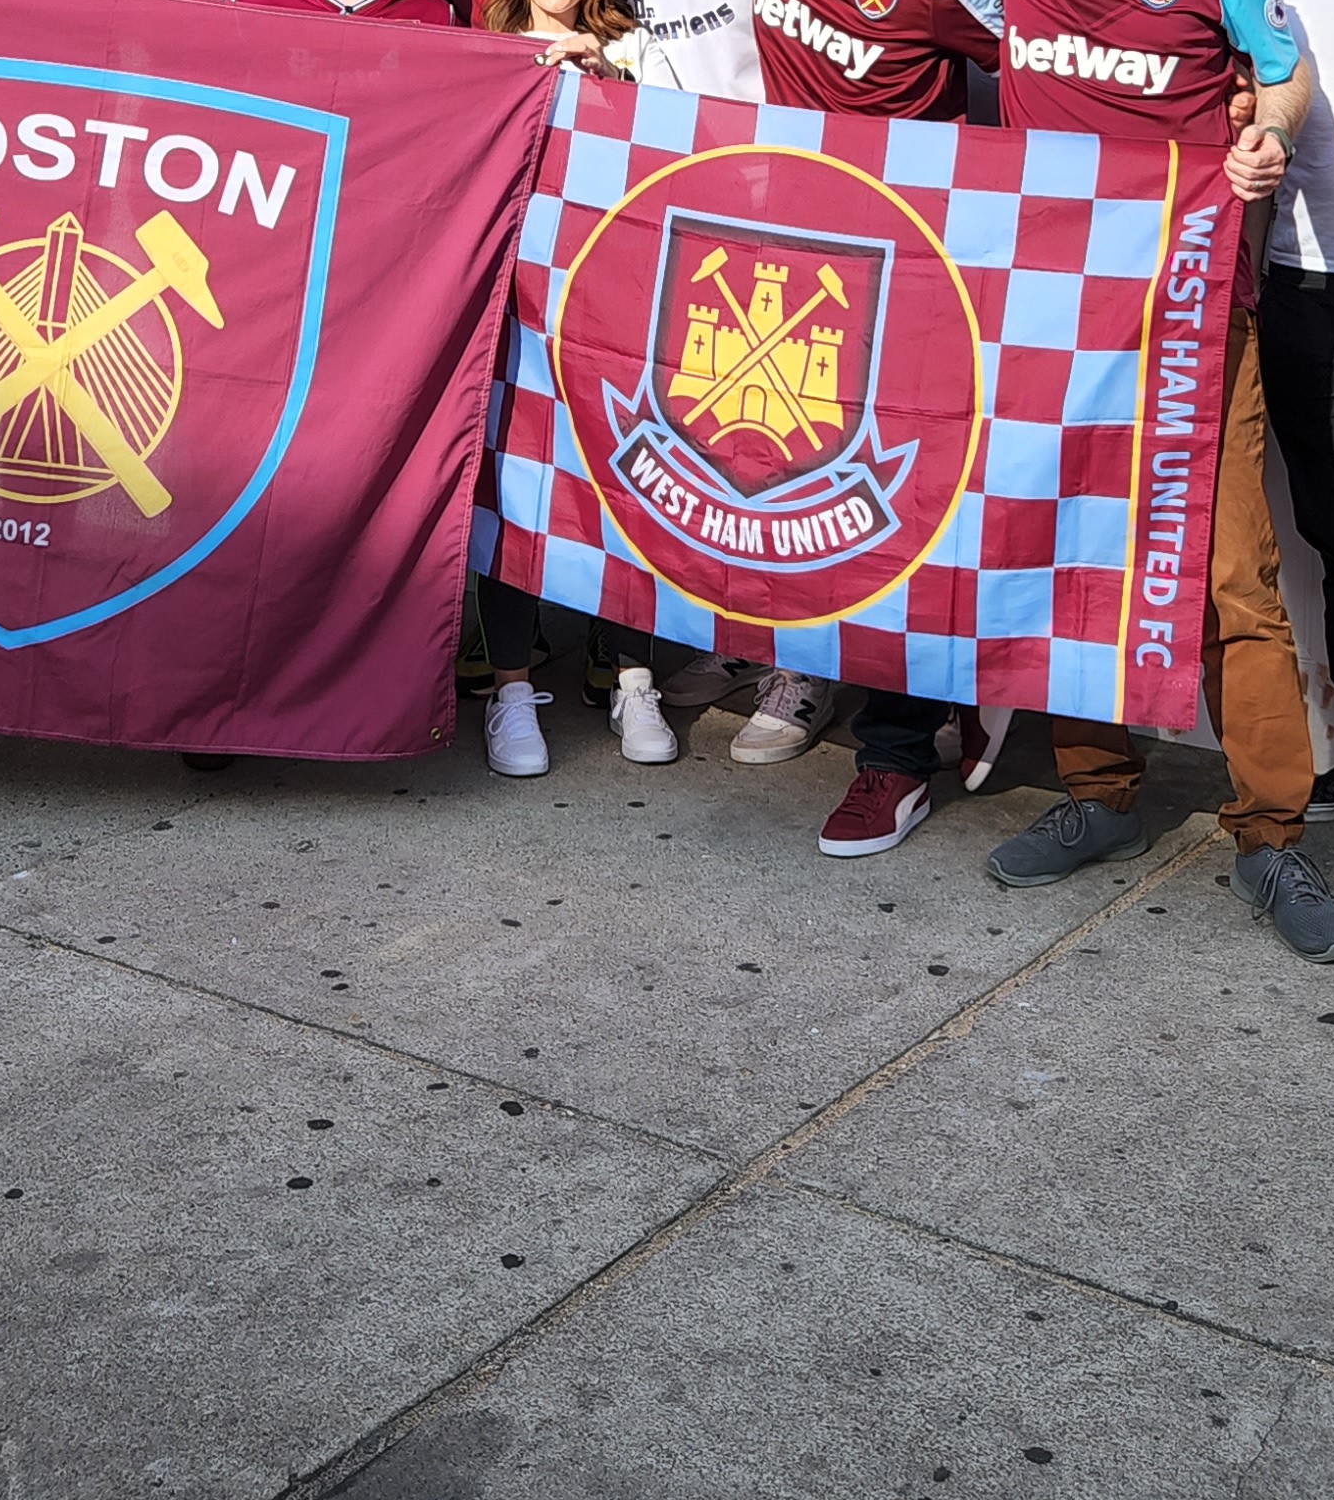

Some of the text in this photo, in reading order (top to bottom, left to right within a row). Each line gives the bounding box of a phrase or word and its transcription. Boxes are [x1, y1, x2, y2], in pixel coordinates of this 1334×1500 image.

[1008, 25, 1179, 95] betway
[1134, 205, 1218, 670] WEST HAM UNITED FC
[630, 448, 874, 556] WEST HAM UNITED
